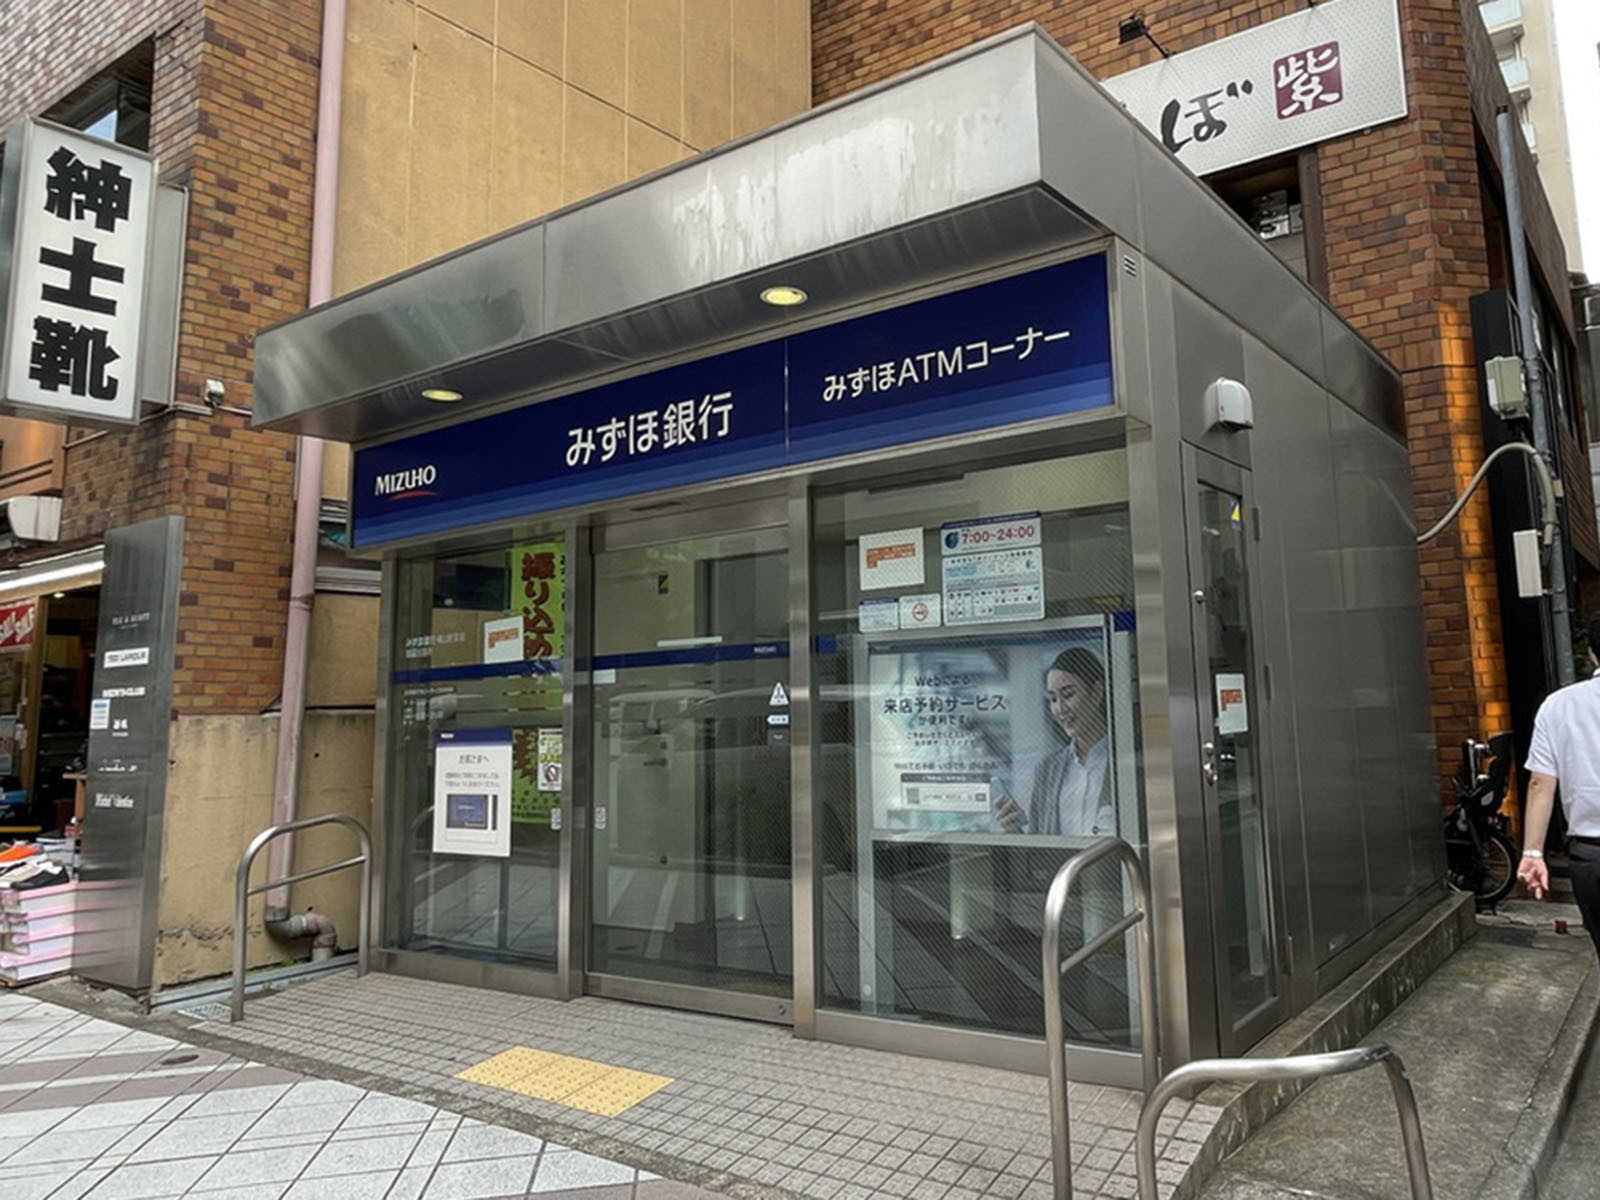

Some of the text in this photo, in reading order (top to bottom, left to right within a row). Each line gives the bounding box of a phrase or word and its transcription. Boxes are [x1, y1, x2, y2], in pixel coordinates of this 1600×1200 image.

[1277, 48, 1340, 116] 紫
[28, 146, 133, 401] 紳士靴
[822, 327, 1071, 402] みずほATMコーナー
[565, 391, 734, 467] みずほ銀行
[374, 465, 437, 497] MIZUHO
[883, 694, 1007, 714] 来店予約サービス
